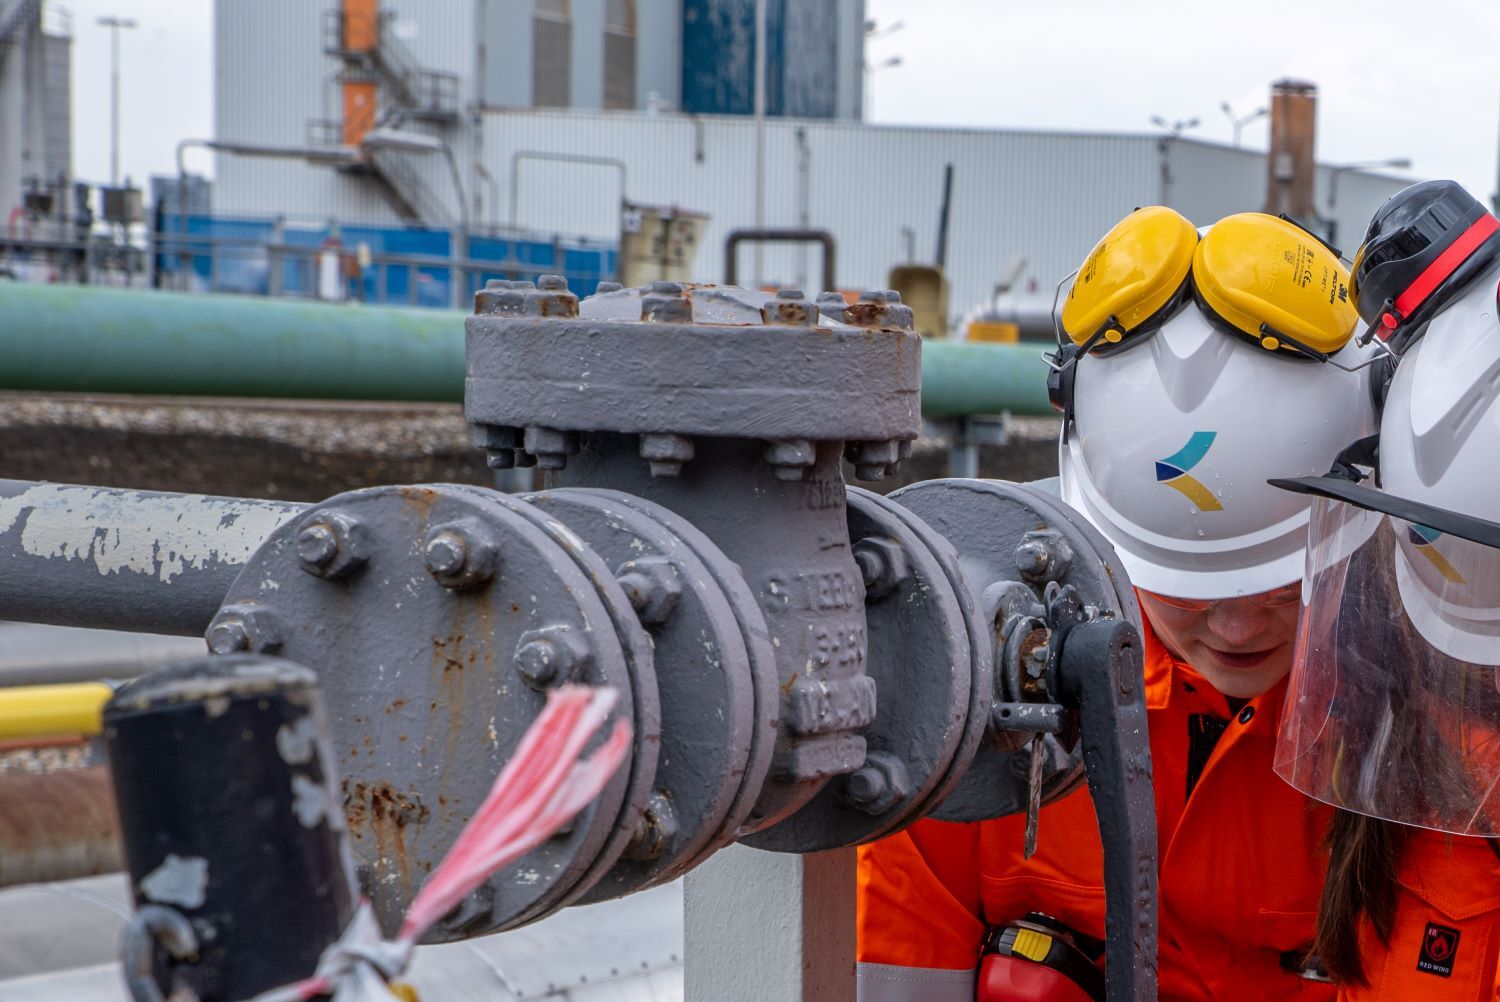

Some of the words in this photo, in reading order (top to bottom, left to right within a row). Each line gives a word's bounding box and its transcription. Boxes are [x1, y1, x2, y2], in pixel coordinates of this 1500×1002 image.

[1329, 270, 1338, 305] PELTOR
[1338, 283, 1348, 304] 3M
[1419, 961, 1432, 969] RED
[1432, 964, 1450, 973] WING
